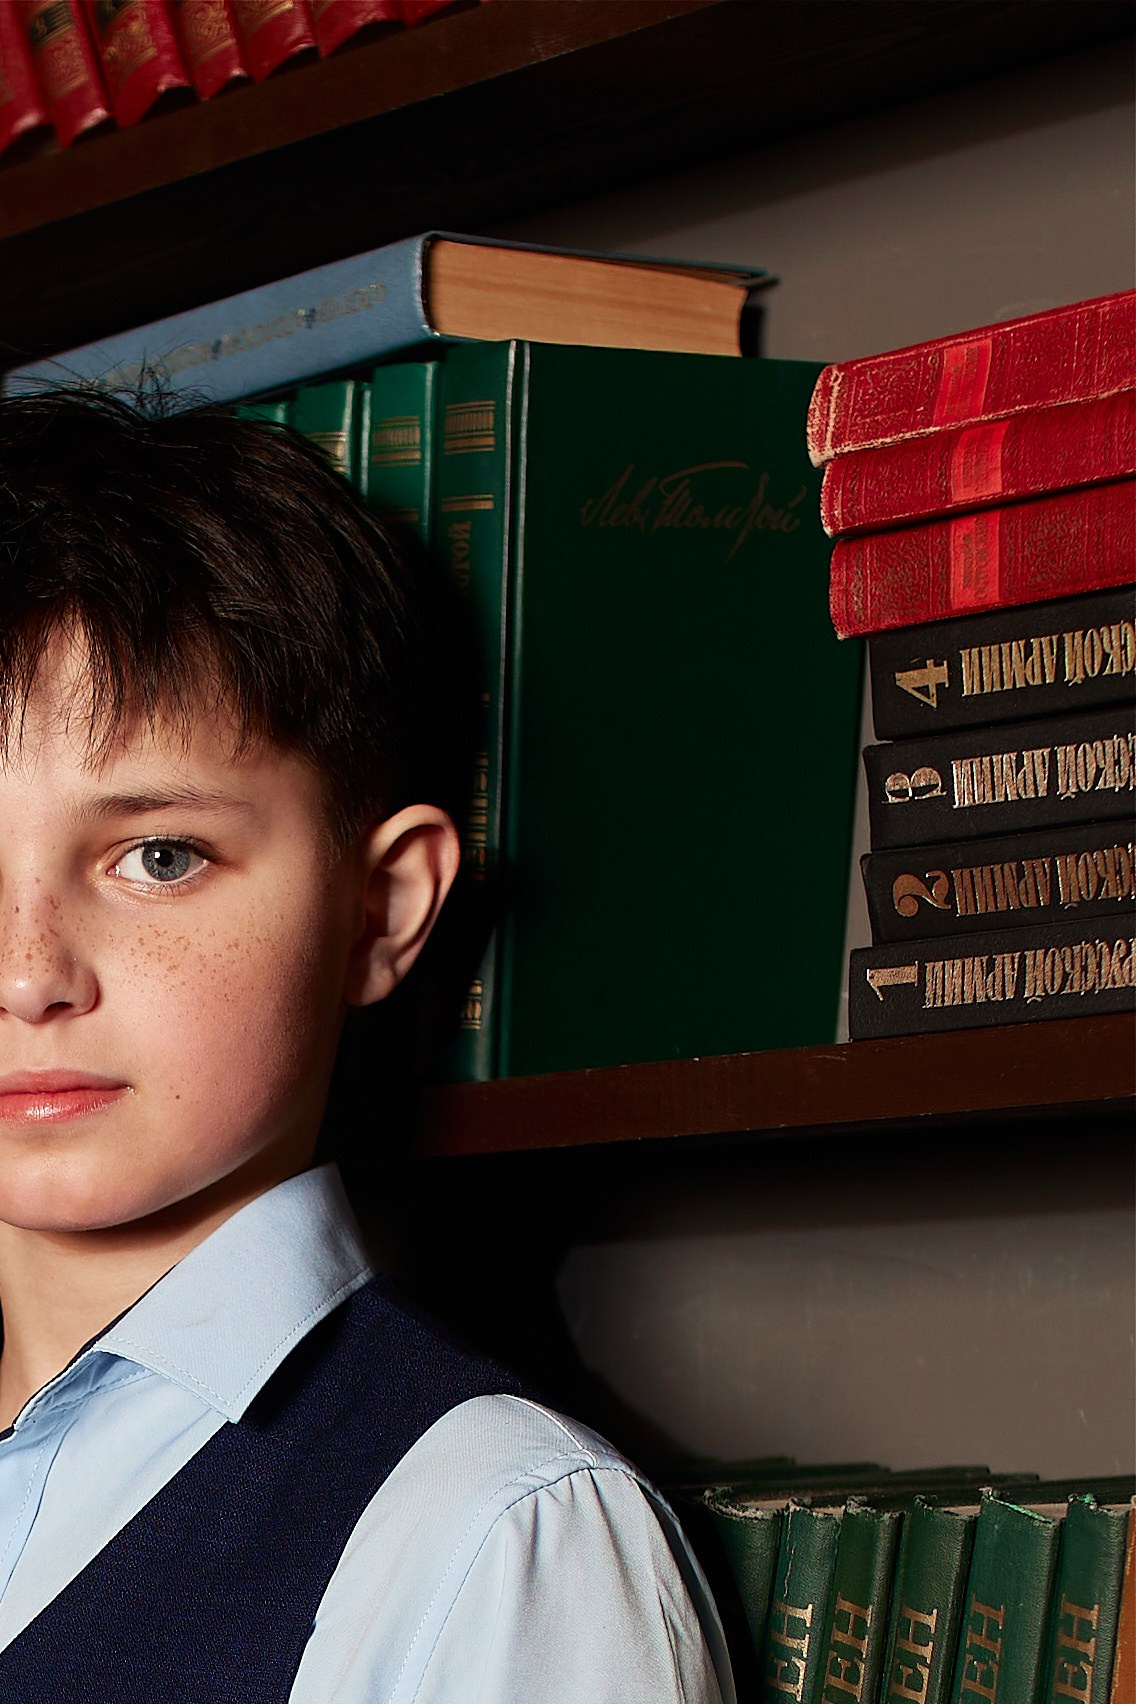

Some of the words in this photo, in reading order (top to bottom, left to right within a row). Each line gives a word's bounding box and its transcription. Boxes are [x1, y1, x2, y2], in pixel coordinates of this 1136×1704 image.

[959, 634, 1060, 698] АРМИИ
[1063, 618, 1136, 687] СКОЙ
[895, 656, 950, 709] 4
[881, 765, 948, 804] 3
[950, 747, 1053, 809] АРМИИ
[892, 870, 952, 918] 2
[950, 856, 1054, 917] АРМИИ
[866, 960, 919, 1002] 1
[921, 951, 1024, 1009] АРМИИ
